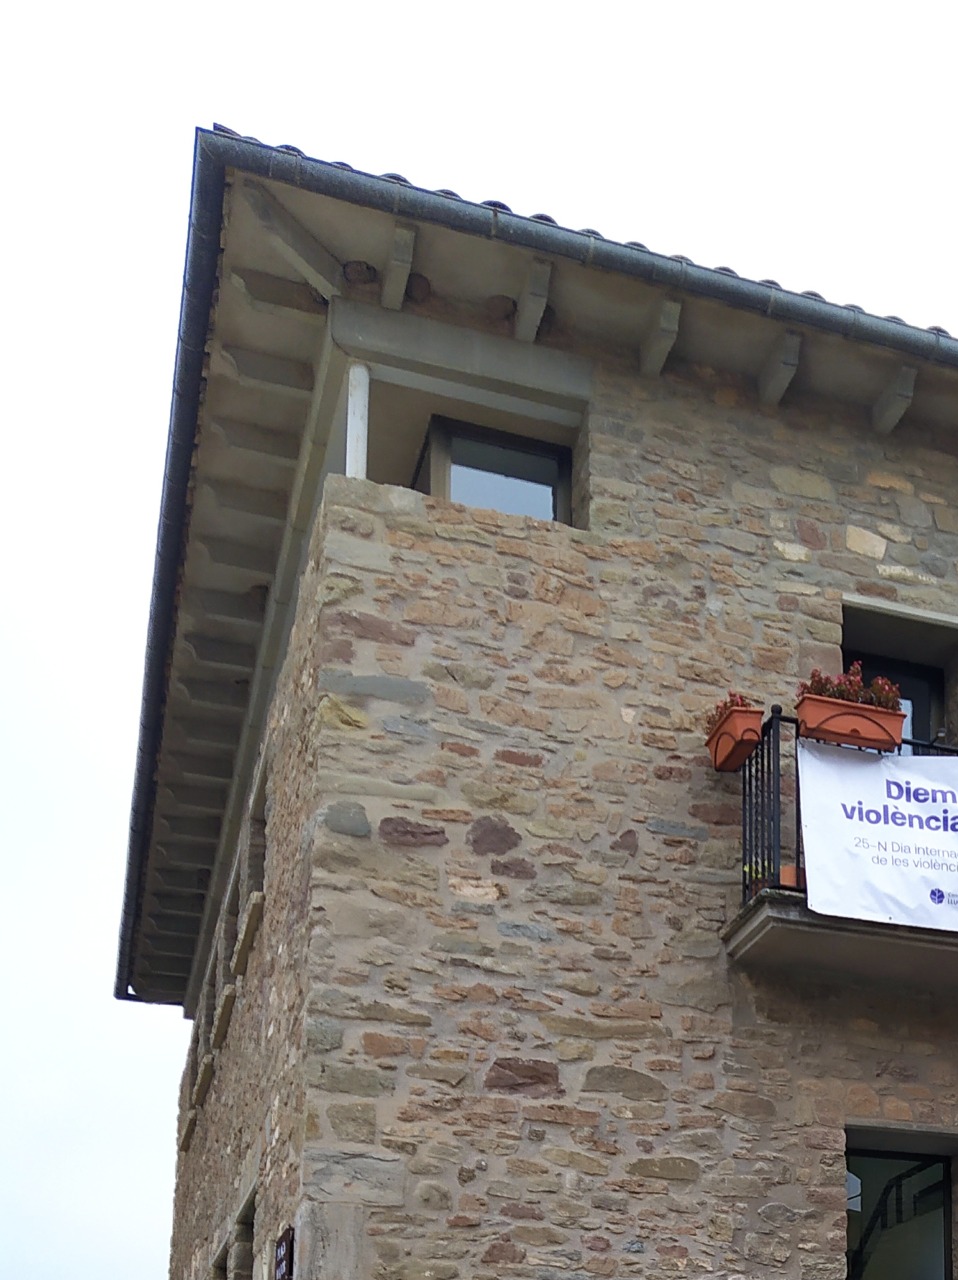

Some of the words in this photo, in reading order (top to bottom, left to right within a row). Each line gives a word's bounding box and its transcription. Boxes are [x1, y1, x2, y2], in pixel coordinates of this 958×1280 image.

[885, 779, 957, 803] Diem
[891, 841, 911, 854] Dia
[871, 855, 888, 866] de
[891, 855, 909, 868] les
